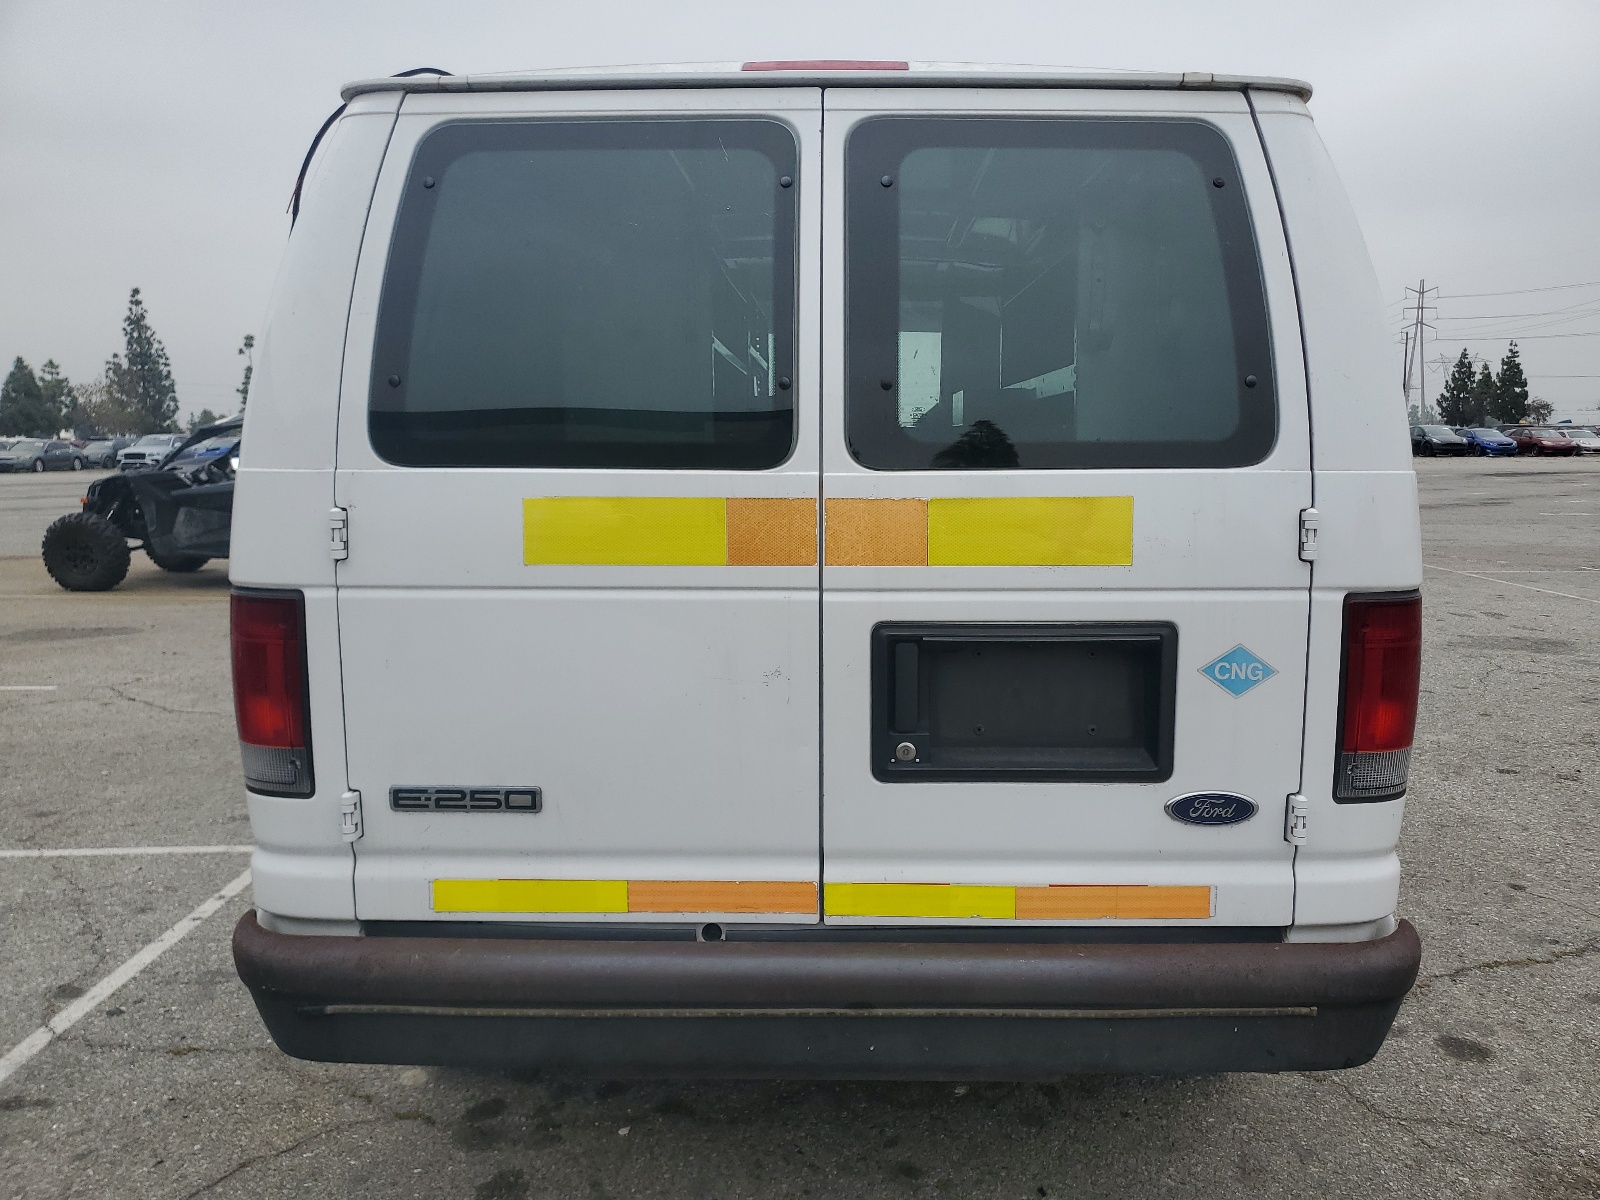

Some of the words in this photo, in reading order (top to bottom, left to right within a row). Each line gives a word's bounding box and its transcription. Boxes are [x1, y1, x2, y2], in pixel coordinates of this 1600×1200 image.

[1214, 662, 1263, 681] CNG
[392, 788, 537, 811] E-250
[1189, 798, 1236, 818] Ford
